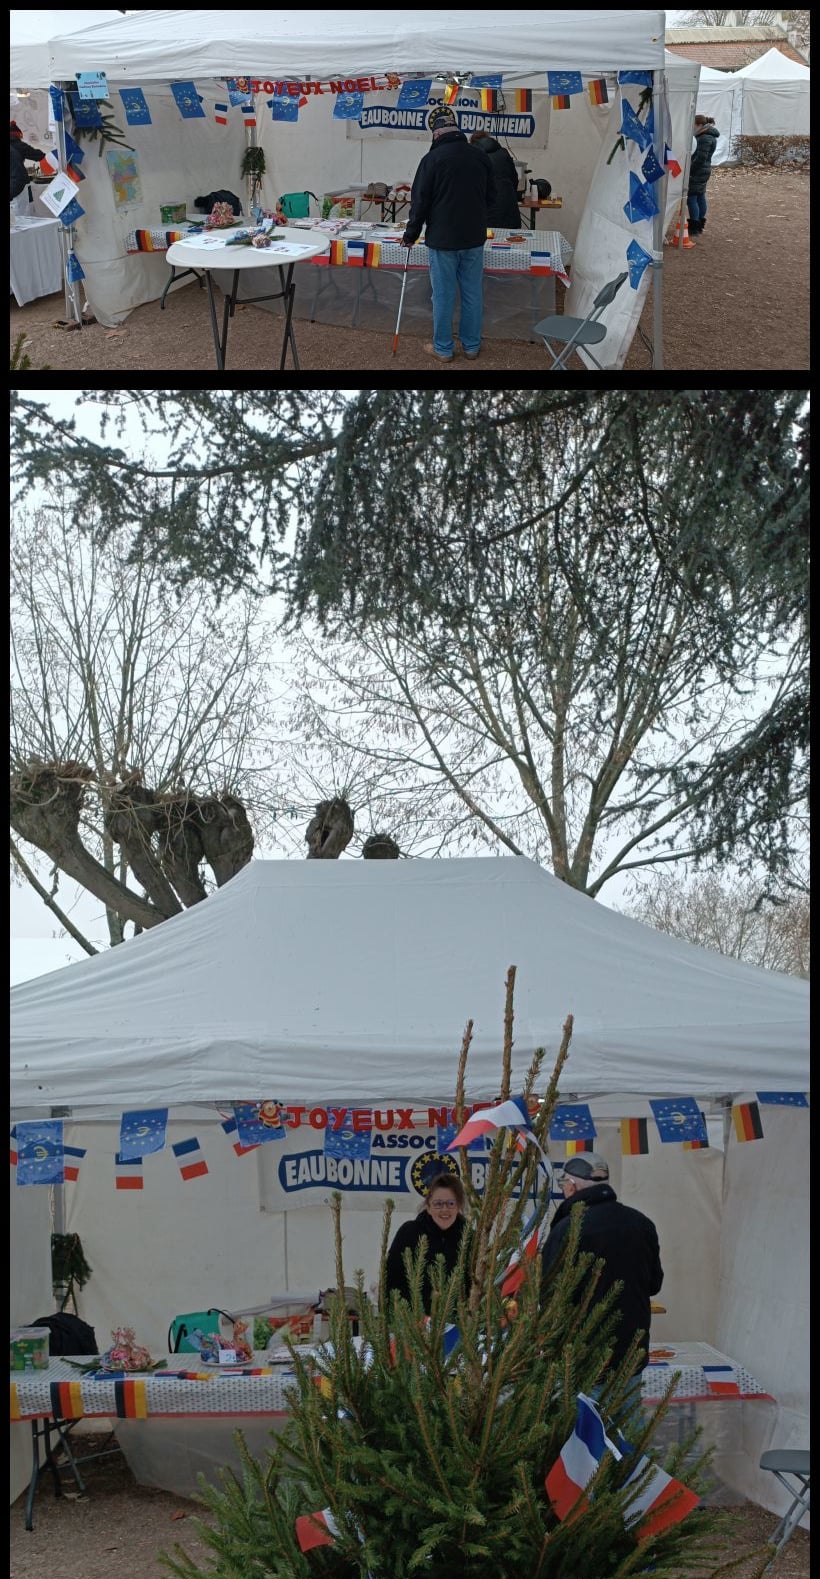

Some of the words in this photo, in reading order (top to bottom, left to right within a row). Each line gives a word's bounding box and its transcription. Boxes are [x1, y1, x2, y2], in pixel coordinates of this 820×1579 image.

[251, 80, 325, 95] JOYEUX
[329, 77, 384, 93] NOEL
[362, 108, 423, 127] EAUBONNE
[460, 114, 531, 134] BUDENHEIM
[287, 1107, 415, 1131] JOYEUX
[285, 1155, 401, 1186] EAUBONNE
